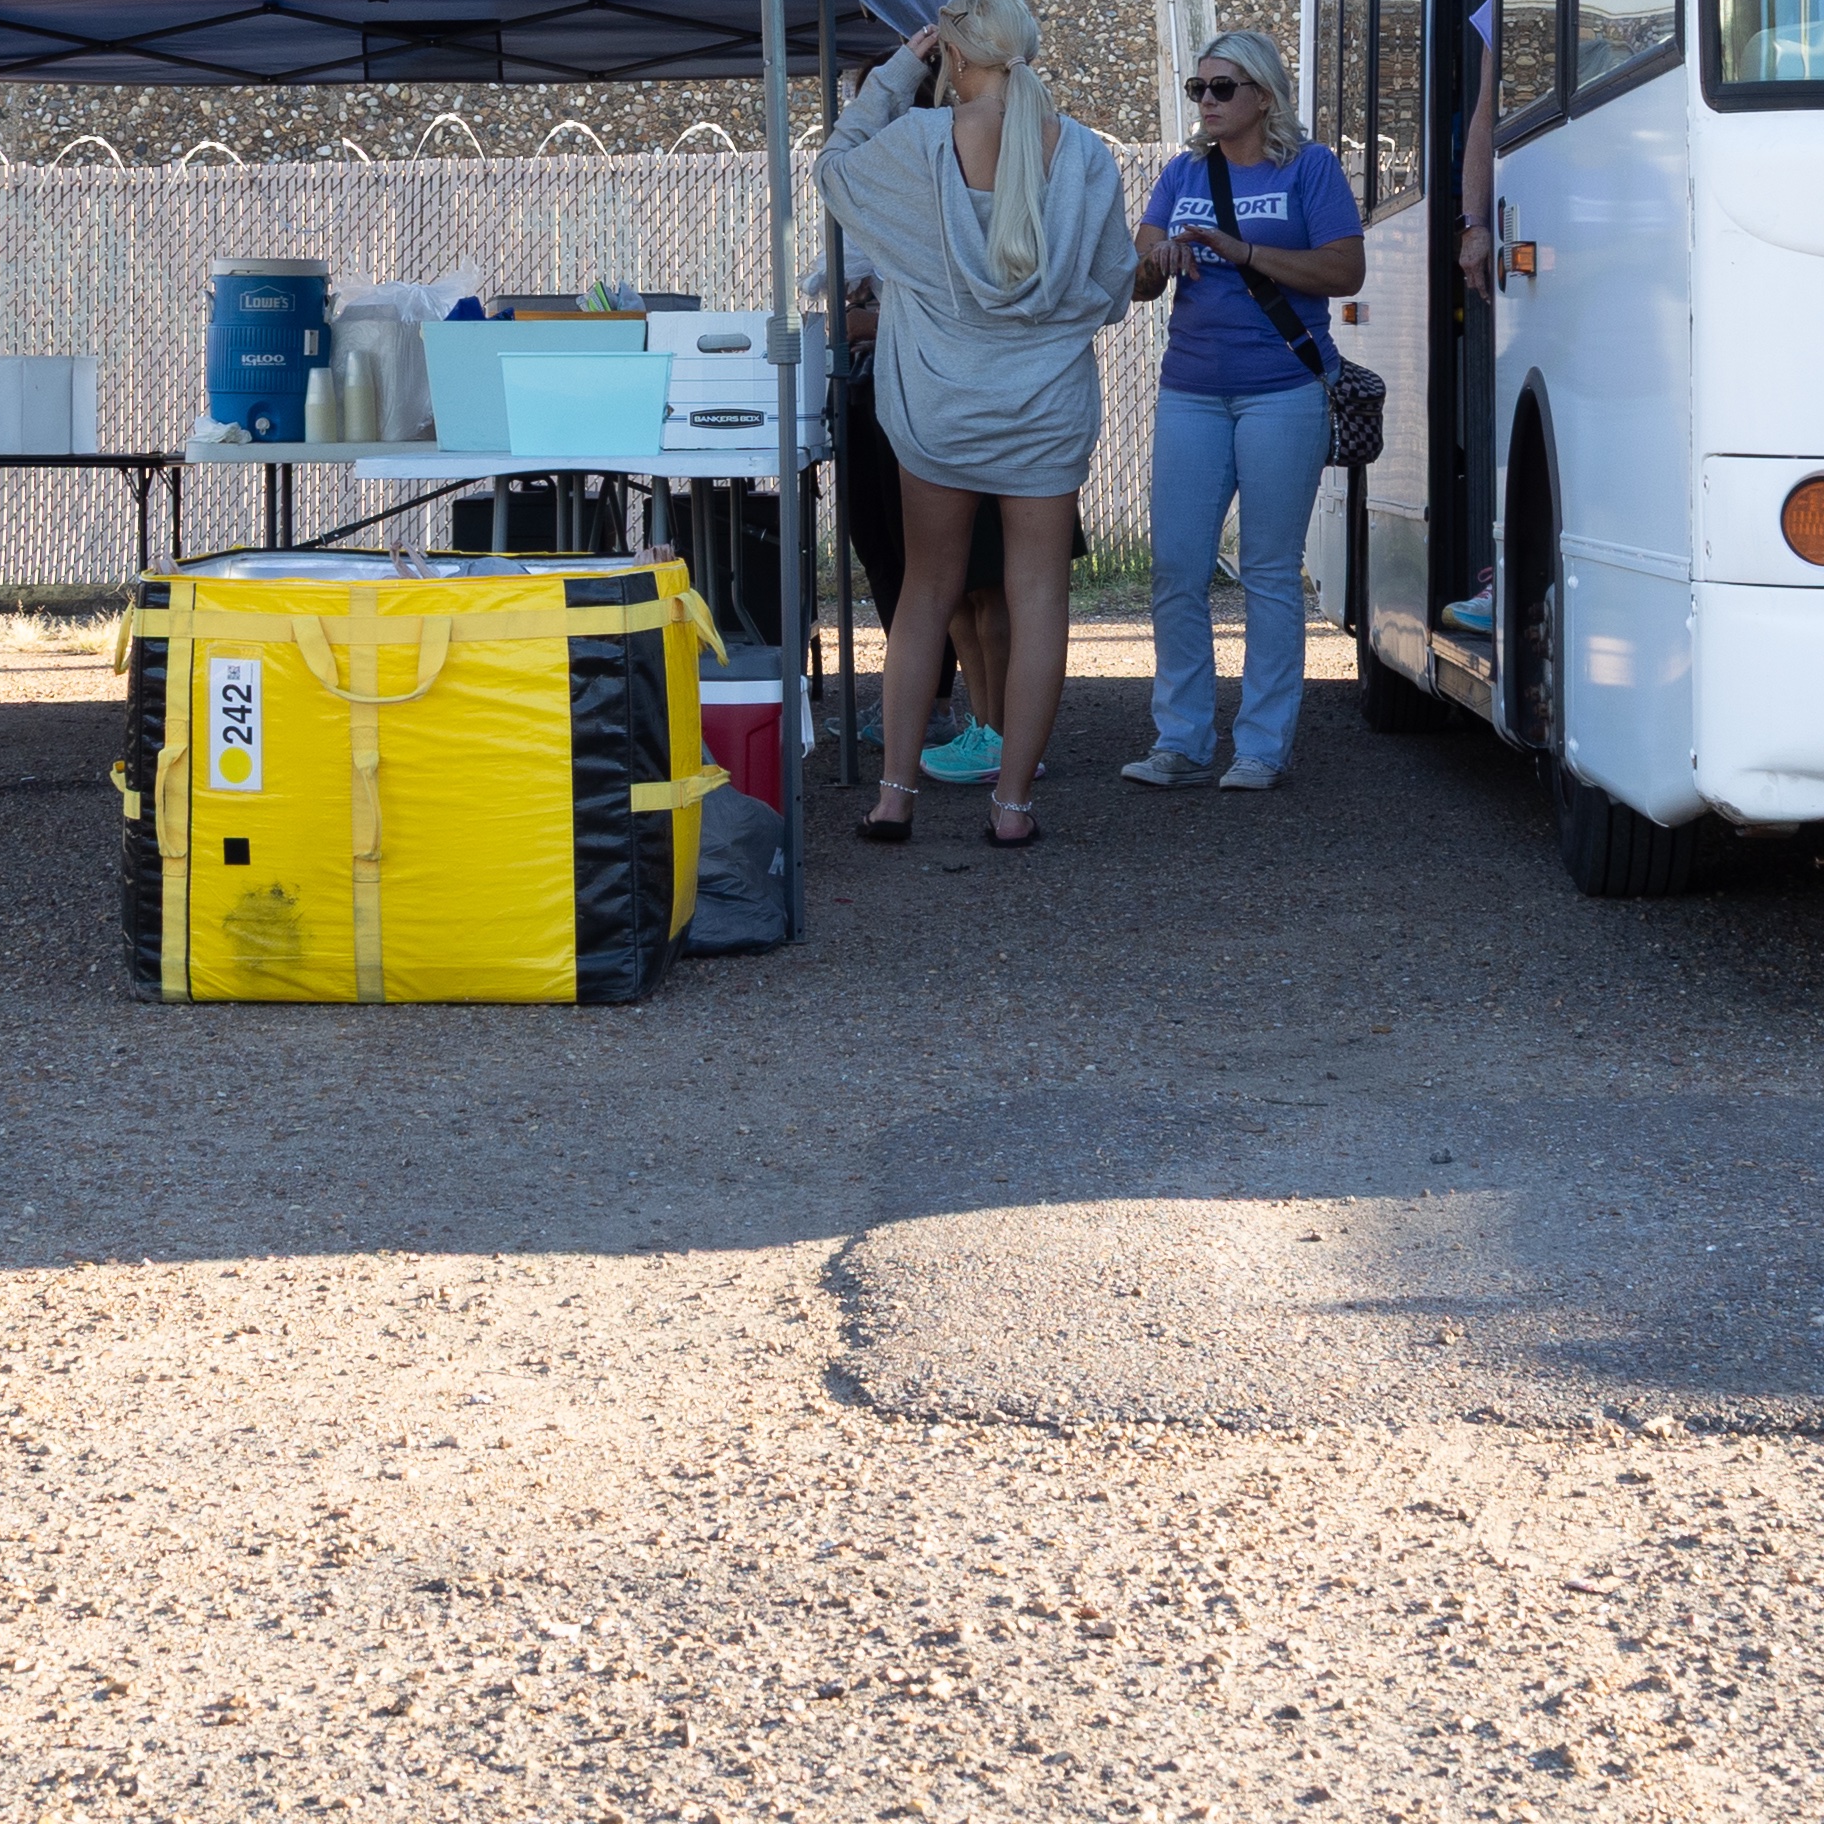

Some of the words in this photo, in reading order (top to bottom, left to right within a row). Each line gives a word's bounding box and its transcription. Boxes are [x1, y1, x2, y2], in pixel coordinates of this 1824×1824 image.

[1176, 197, 1281, 218] SUORT
[241, 354, 285, 366] IGLOO
[694, 415, 738, 423] BANKERS
[222, 684, 253, 745] 242
